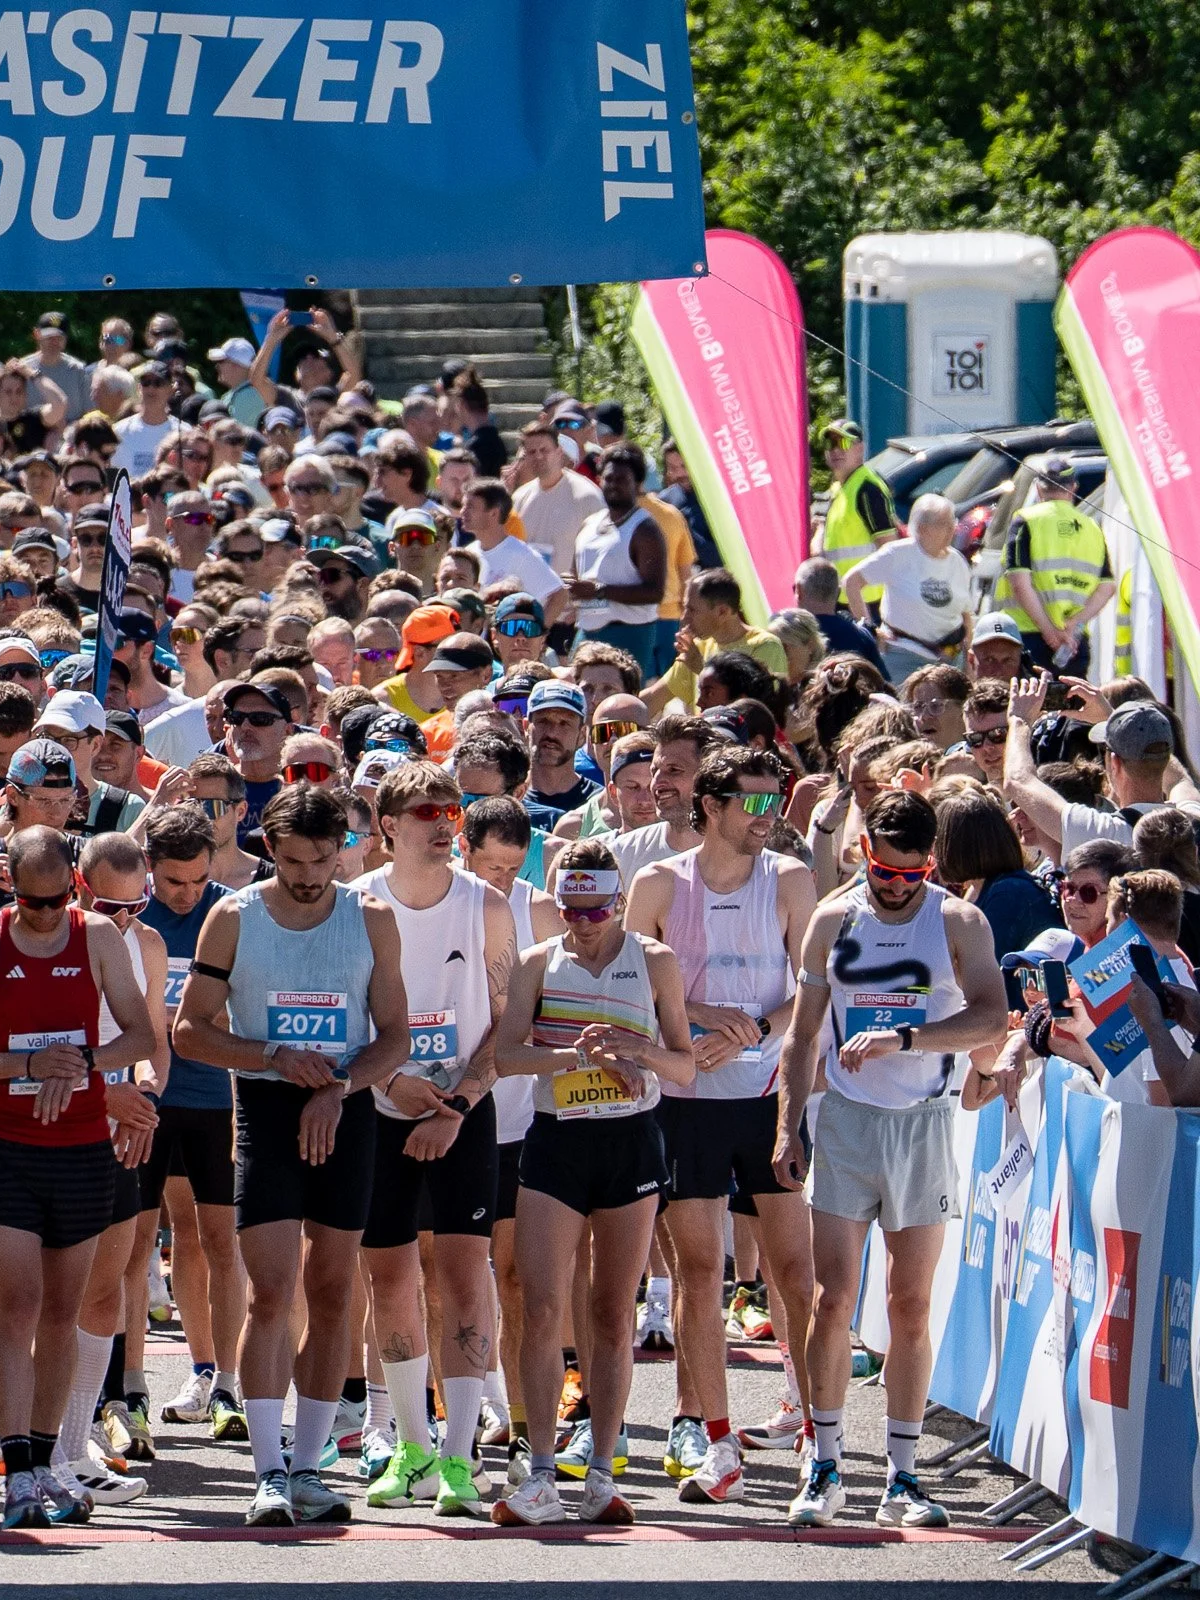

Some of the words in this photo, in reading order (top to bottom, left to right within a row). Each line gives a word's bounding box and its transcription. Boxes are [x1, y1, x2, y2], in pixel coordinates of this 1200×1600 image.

[596, 41, 675, 223] ZIEL
[946, 369, 984, 390] TOI
[563, 884, 579, 892] Red
[579, 884, 597, 892] Bull
[611, 970, 638, 980] HOKA
[874, 1010, 892, 1022] 22
[277, 1013, 336, 1036] 2071
[27, 1035, 72, 1048] valiant
[586, 1073, 602, 1084] 11
[566, 1087, 626, 1104] JUDITH
[990, 1142, 1028, 1195] valiant
[636, 1180, 659, 1193] HOKA
